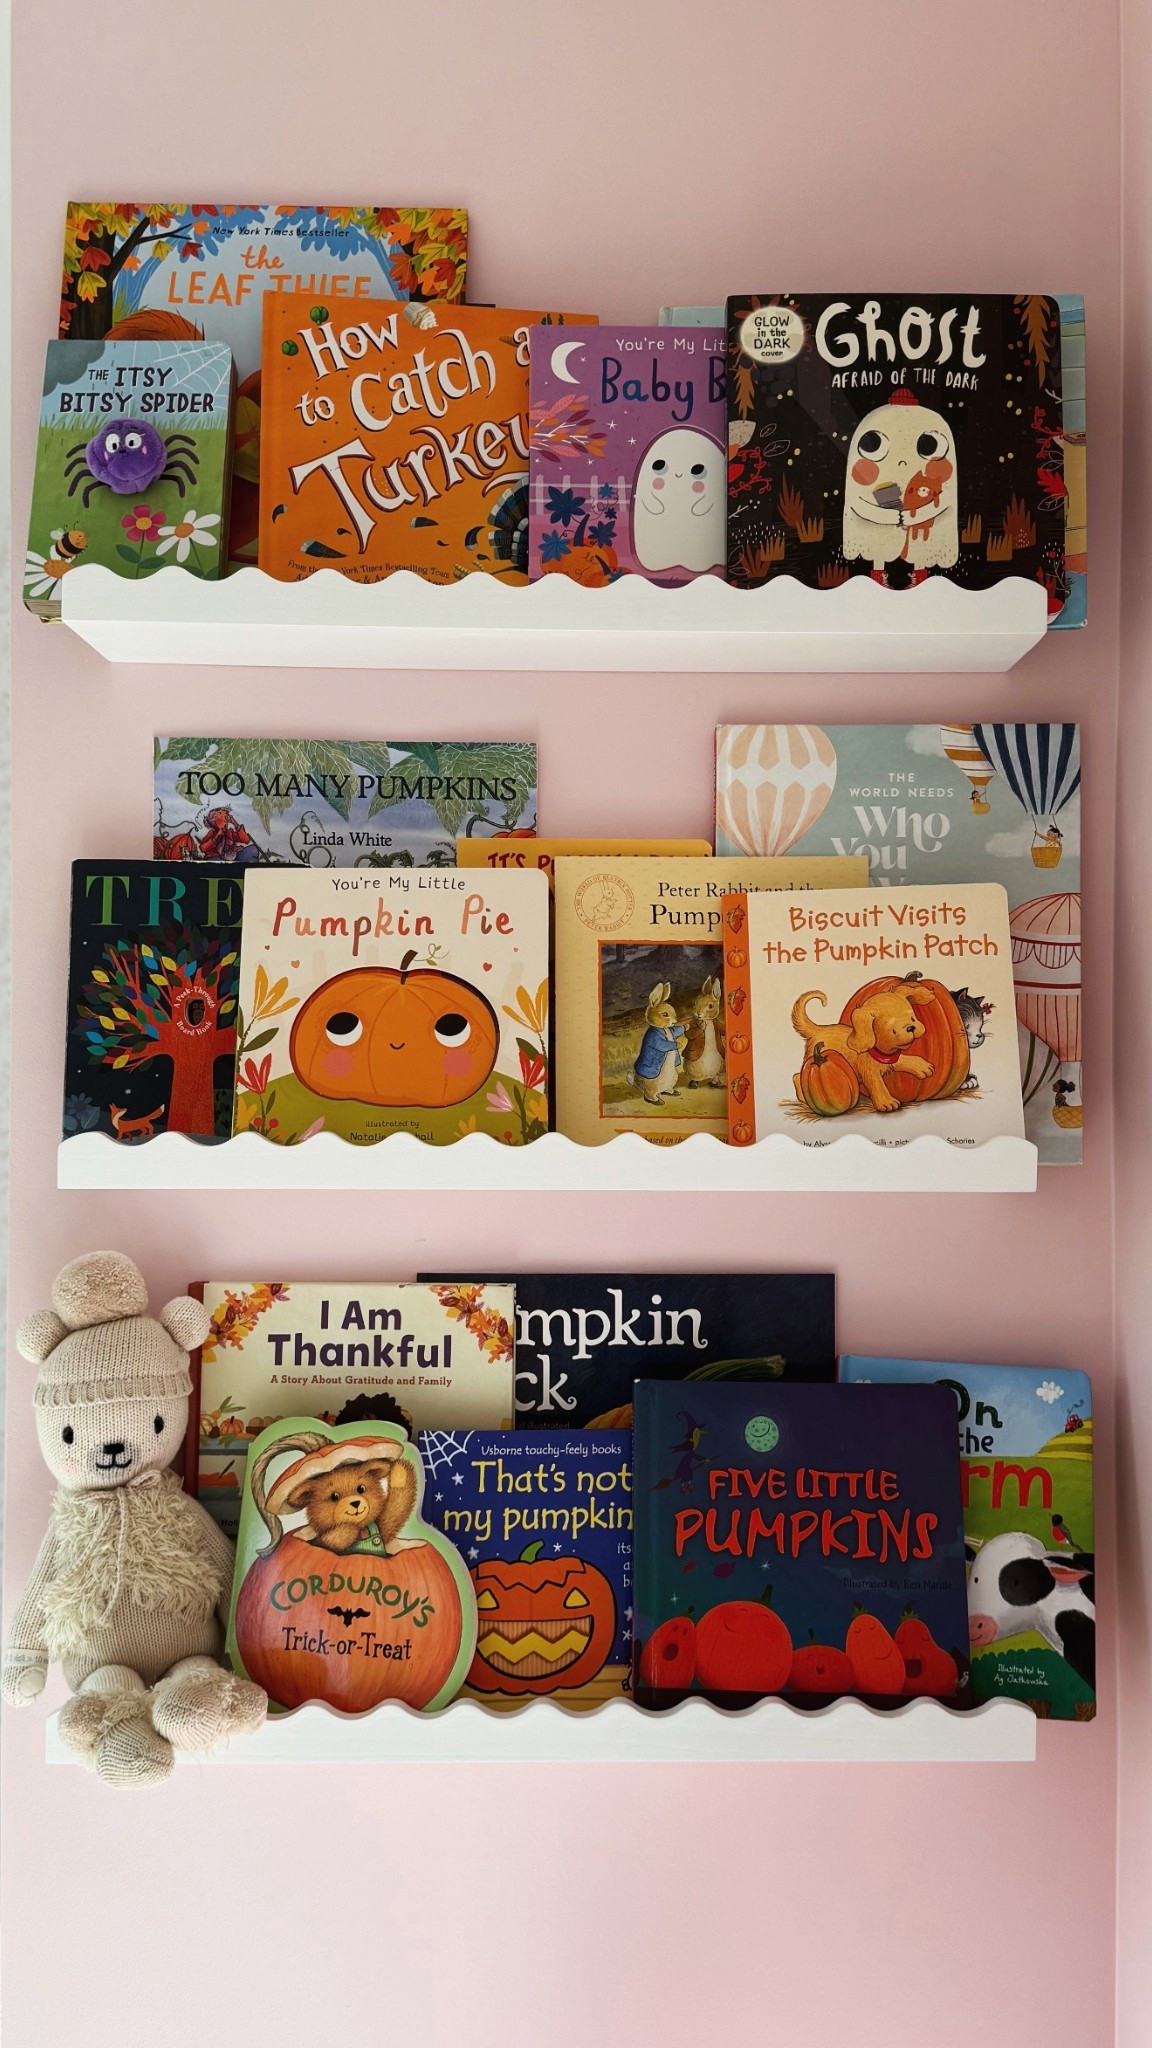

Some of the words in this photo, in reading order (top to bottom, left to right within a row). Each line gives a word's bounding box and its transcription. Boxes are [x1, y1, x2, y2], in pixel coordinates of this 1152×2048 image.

[212, 227, 234, 235] New
[238, 227, 260, 235] York
[264, 228, 294, 236] Times
[241, 244, 285, 269] the
[168, 271, 254, 307] LEAF
[269, 274, 371, 298] THIEF
[754, 316, 789, 327] GLOW
[757, 328, 766, 337] in
[770, 328, 786, 336] the
[616, 338, 665, 352] You're
[674, 338, 695, 354] My
[753, 338, 790, 349] DARK
[815, 301, 986, 368] Ghost
[298, 313, 398, 381] How
[88, 369, 109, 381] THE
[115, 367, 172, 387] ITSY
[294, 391, 336, 426] to
[350, 329, 496, 432] Catch
[832, 371, 883, 388] AFRAID
[891, 368, 906, 385] OF
[913, 368, 937, 386] THE
[946, 373, 979, 391] DARK
[602, 357, 694, 421] Baby
[60, 392, 133, 413] BITSY
[140, 393, 214, 413] SPIDER
[288, 560, 307, 571] From
[361, 565, 382, 573] Times
[431, 568, 449, 579] Team
[178, 771, 245, 797] TOO
[255, 773, 350, 799] MANY
[358, 775, 517, 801] PUMPKINS
[888, 773, 915, 782] THE
[849, 787, 899, 797] WORLD
[908, 788, 955, 797] NEEDS
[302, 832, 344, 847] Linda
[348, 832, 392, 847] White
[853, 805, 950, 853] Who
[332, 877, 381, 891] You're
[389, 876, 410, 892] My
[418, 876, 466, 890] Little
[658, 882, 700, 897] Peter
[705, 882, 760, 898] Rabbit
[272, 897, 434, 956] Pumpkin
[460, 894, 514, 935] Pie
[788, 905, 883, 932] Biscuit
[887, 901, 967, 928] Visits
[763, 941, 807, 964] the
[814, 936, 917, 967] Pumpkin
[924, 933, 999, 959] Patch
[176, 1021, 195, 1036] Board
[196, 1021, 213, 1036] Book
[320, 1300, 329, 1330] I
[341, 1300, 401, 1330] Am
[268, 1333, 452, 1368] Thankful
[270, 1375, 279, 1384] A
[281, 1375, 308, 1386] Story
[311, 1375, 342, 1384] About
[345, 1375, 394, 1385] Gratitude
[397, 1376, 415, 1385] and
[418, 1376, 452, 1388] Family
[481, 1444, 522, 1456] Usborne
[525, 1443, 589, 1458] touchy-feely
[592, 1443, 622, 1454] books
[471, 1459, 566, 1493] That's
[577, 1463, 632, 1493] not
[708, 1468, 787, 1499] FIVE
[796, 1468, 900, 1500] LITTLE
[443, 1508, 491, 1541] my
[502, 1497, 633, 1541] pumpkin
[674, 1507, 938, 1563] PUMPKINS
[843, 1577, 888, 1589] Illustrated
[890, 1579, 900, 1590] by
[903, 1578, 921, 1589] Ben
[270, 1573, 435, 1628] CORDUROY'S
[282, 1627, 412, 1660] Trick-or-Treat
[994, 1674, 1004, 1685] Ag
[998, 1664, 1034, 1674] Illustrated
[1037, 1670, 1045, 1678] by
